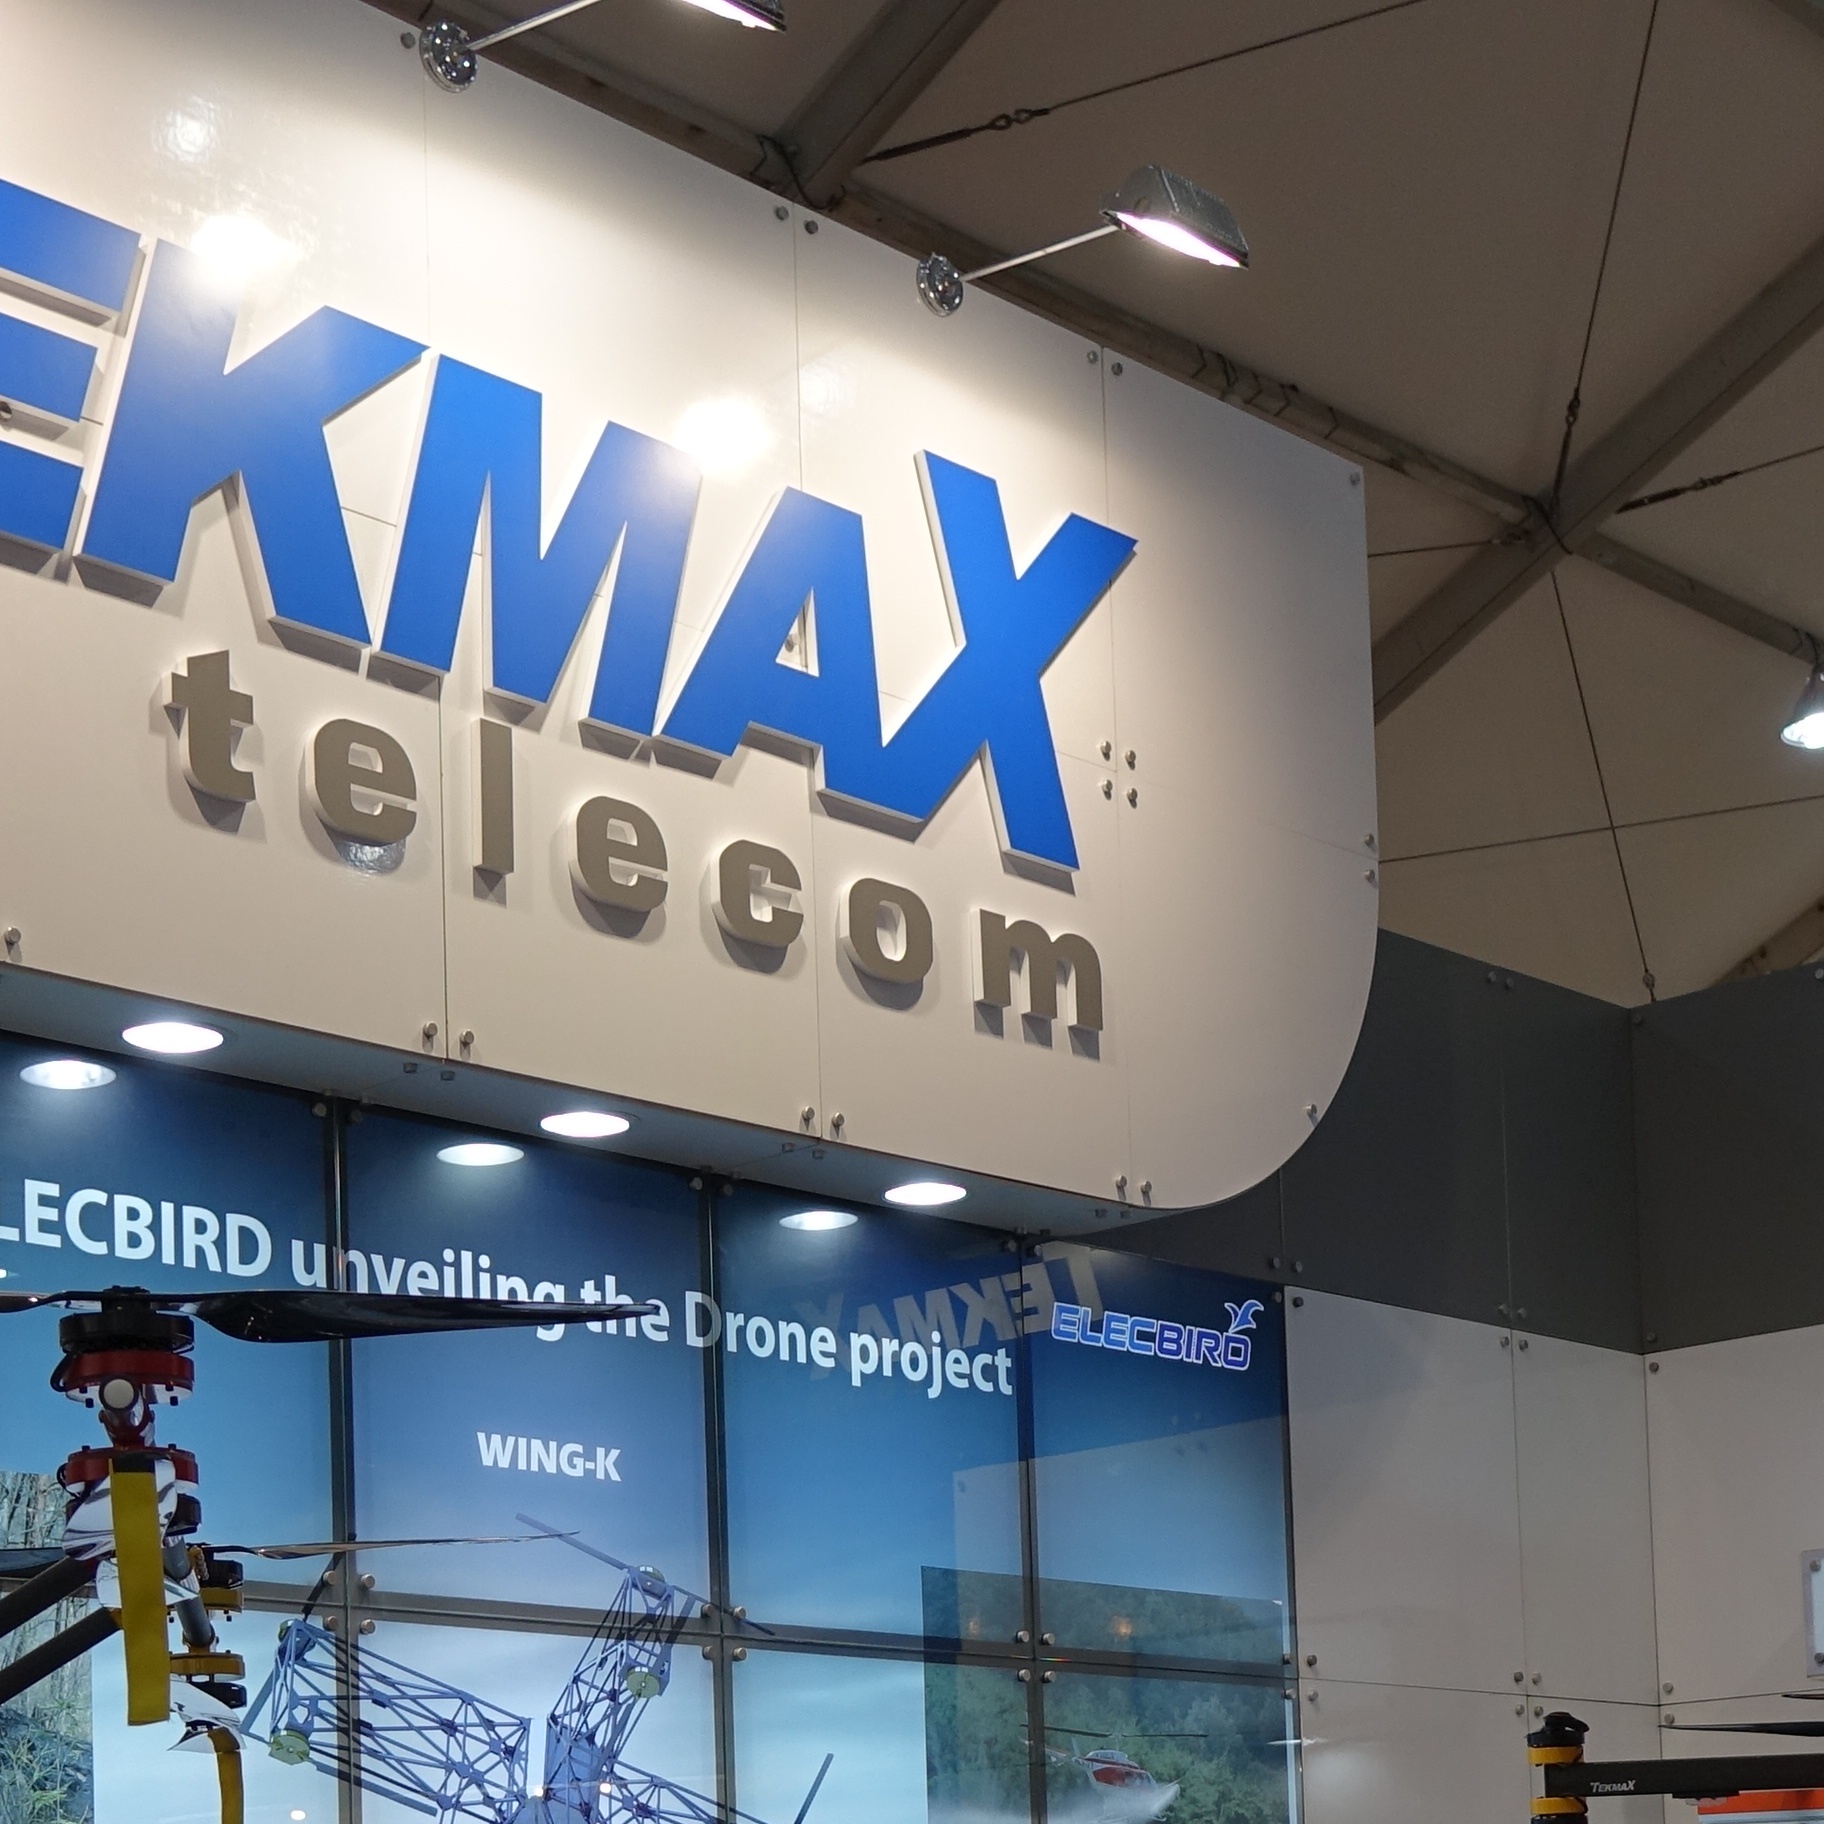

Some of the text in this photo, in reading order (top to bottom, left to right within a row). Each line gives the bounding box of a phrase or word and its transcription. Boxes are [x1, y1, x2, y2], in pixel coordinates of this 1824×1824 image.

[170, 650, 1102, 1033] telecom
[580, 1275, 669, 1343] the
[685, 1290, 836, 1369] Drone
[851, 1331, 1013, 1399] project
[1050, 1301, 1253, 1372] ELECBIRD
[477, 1431, 622, 1483] WING-K
[1589, 1779, 1636, 1794] TEKMAX
